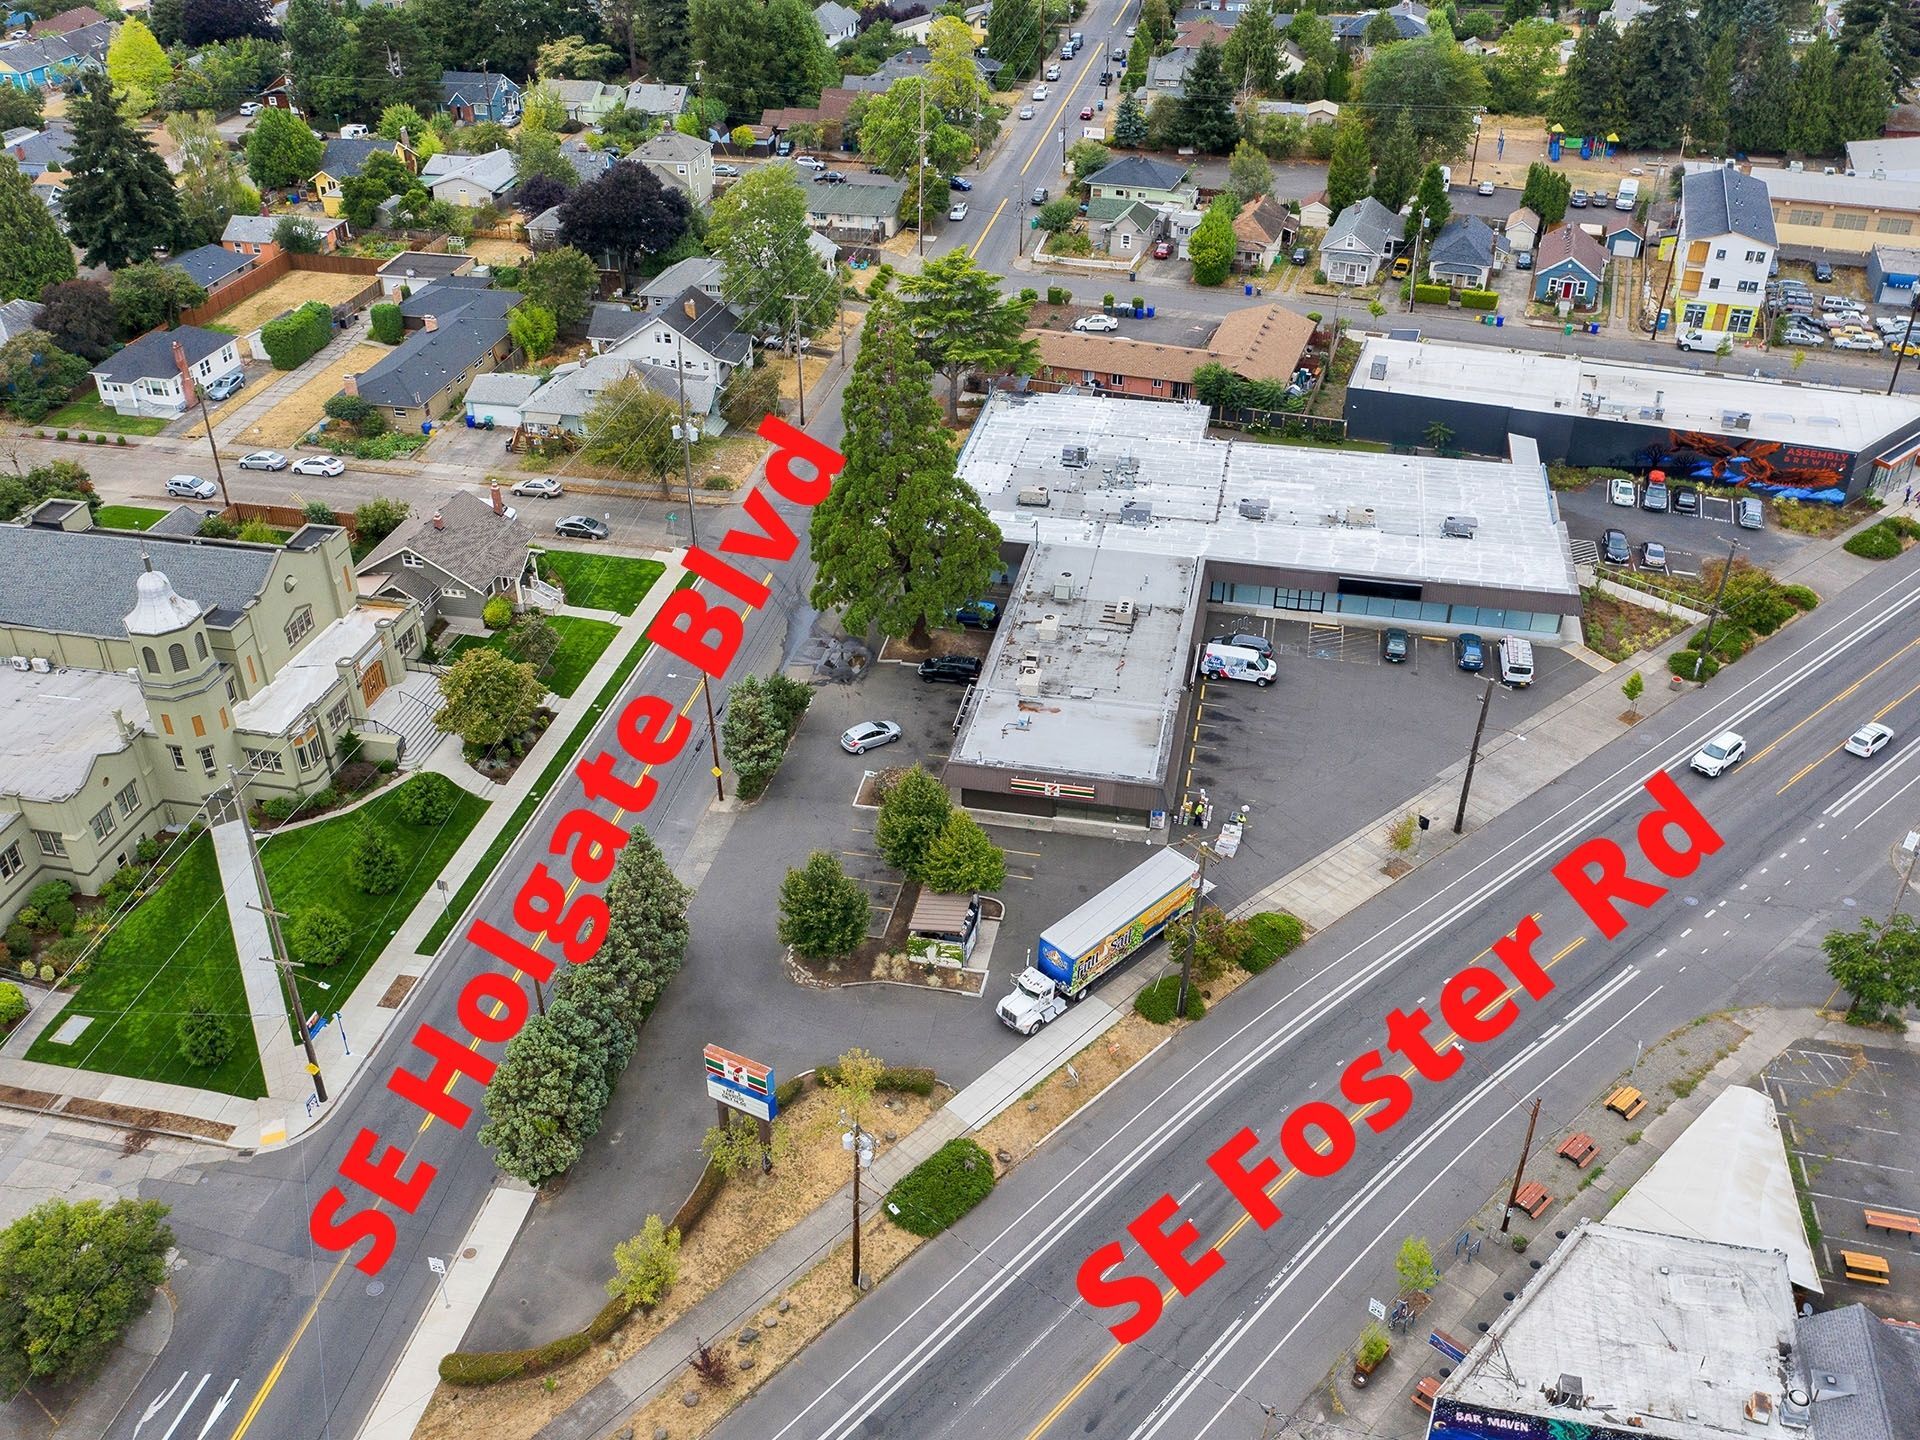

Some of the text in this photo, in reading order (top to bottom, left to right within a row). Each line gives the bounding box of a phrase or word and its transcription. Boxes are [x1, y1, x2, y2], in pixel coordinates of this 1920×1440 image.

[1786, 447, 1849, 462] ASSEMBLY
[1783, 455, 1847, 471] BREWING
[1455, 1411, 1529, 1432] BAR MAVEN
